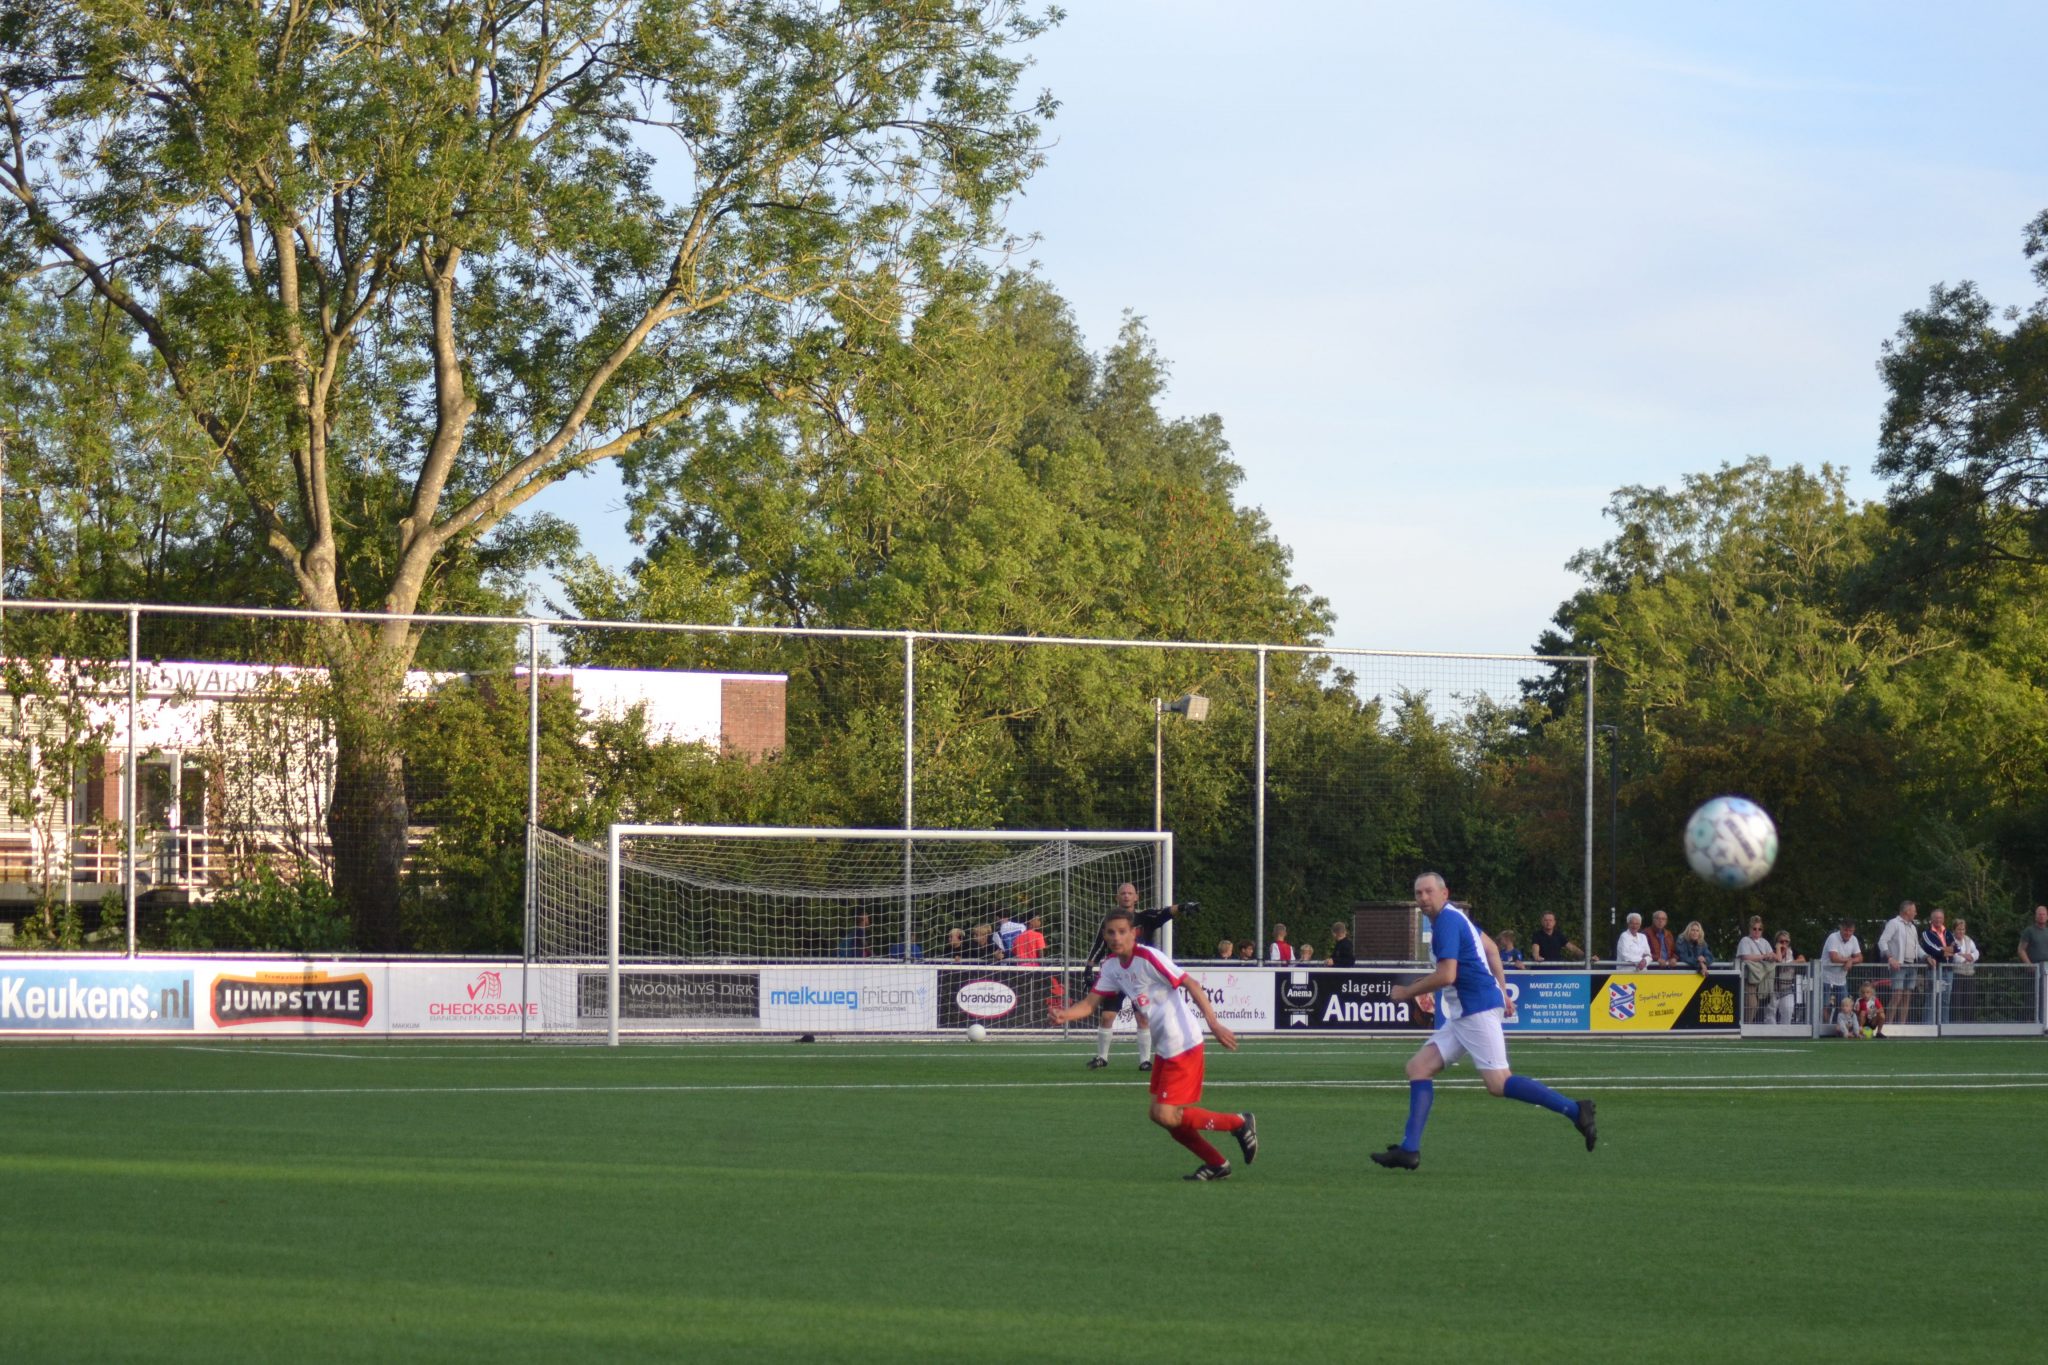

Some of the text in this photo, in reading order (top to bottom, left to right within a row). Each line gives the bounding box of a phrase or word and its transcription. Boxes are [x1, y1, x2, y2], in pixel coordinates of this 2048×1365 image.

[630, 984, 754, 995] WOONHUYS DIRK
[1287, 988, 1313, 997] Anema
[1341, 980, 1391, 996] slagerij
[1, 977, 190, 1019] Keukens.nl
[221, 989, 360, 1011] JUMPSTYLE
[771, 986, 915, 1010] melkweg fritom
[960, 992, 1012, 1003] brandsma
[429, 1003, 538, 1015] CHECK&SAVE
[1323, 994, 1410, 1022] Anema
[1699, 1014, 1734, 1022] SC BOLSWARD
